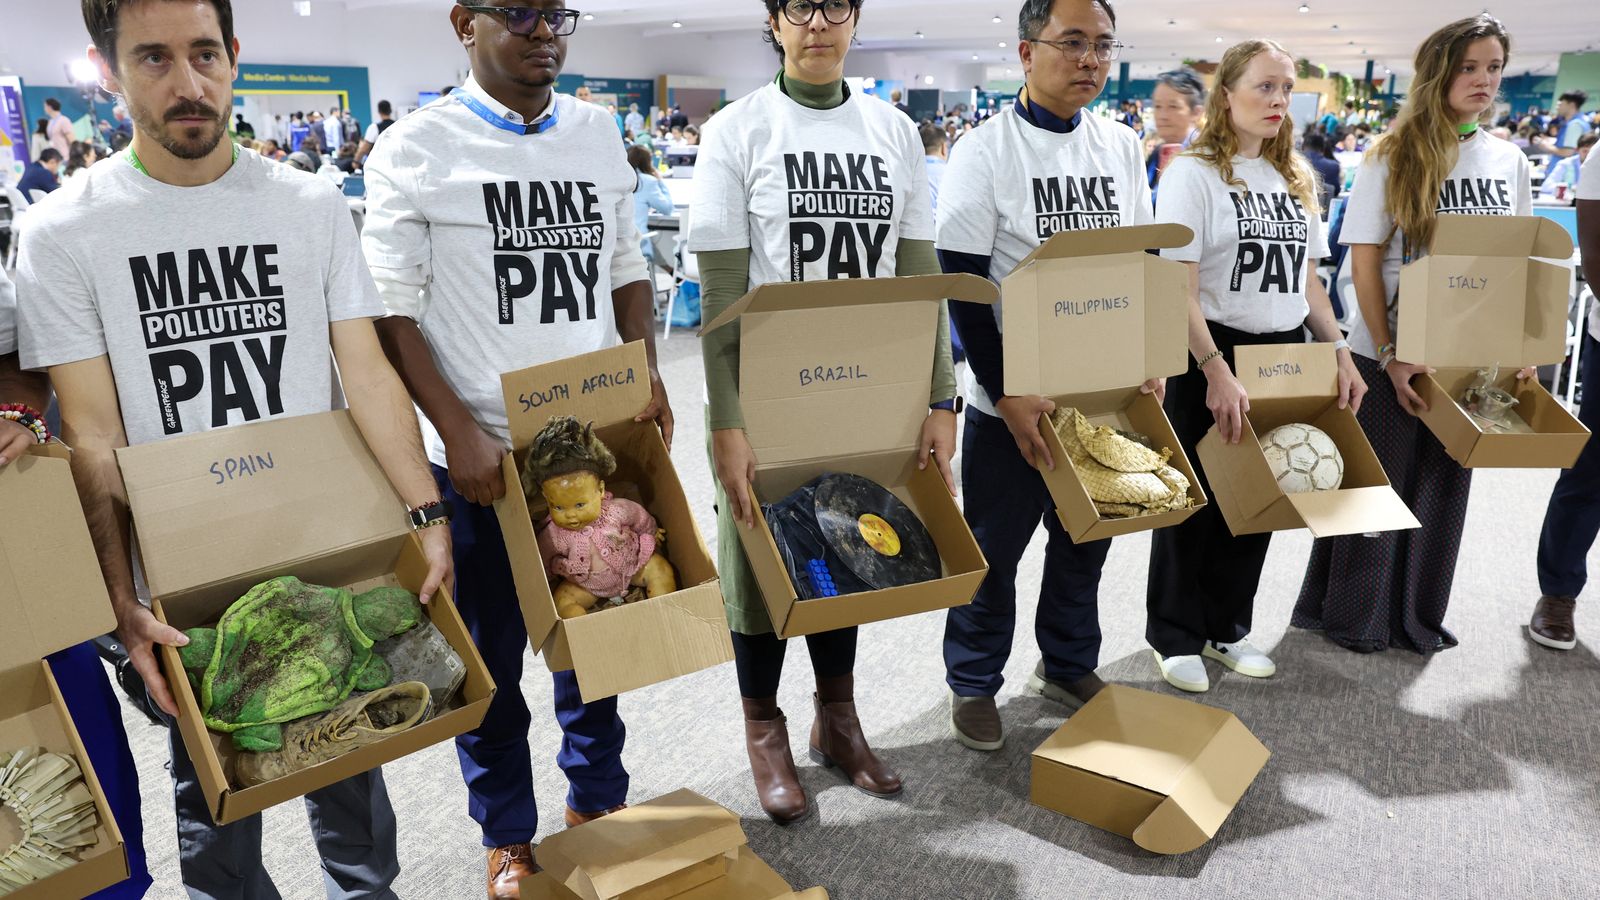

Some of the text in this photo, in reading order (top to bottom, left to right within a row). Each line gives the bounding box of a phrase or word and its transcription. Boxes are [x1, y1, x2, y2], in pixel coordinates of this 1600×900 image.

[783, 151, 893, 193] MAKE
[482, 180, 603, 229] MAKE
[791, 193, 892, 217] POLLUTERS
[1032, 175, 1119, 213] MAKE
[1229, 190, 1306, 222] MAKE
[1437, 178, 1511, 209] MAKE
[497, 225, 602, 248] POLLUTERS
[1240, 219, 1307, 241] POLLUTERS
[789, 221, 891, 282] PAY
[792, 241, 800, 282] GREENPEACE
[1229, 241, 1307, 294] PAY
[128, 243, 284, 312] MAKE
[493, 252, 600, 325] PAY
[499, 275, 509, 320] GREENPEACE
[1448, 275, 1488, 290] ITALY
[145, 301, 283, 343] POLLUTERS
[1054, 296, 1129, 317] PHILIPPINES
[148, 334, 287, 435] PAY
[518, 367, 635, 413] SOUTH AFRICA
[799, 365, 868, 386] BRAZIL
[1258, 363, 1303, 378] AUSTRIA
[158, 378, 176, 429] GREENPEACE
[209, 451, 274, 485] SPAIN
